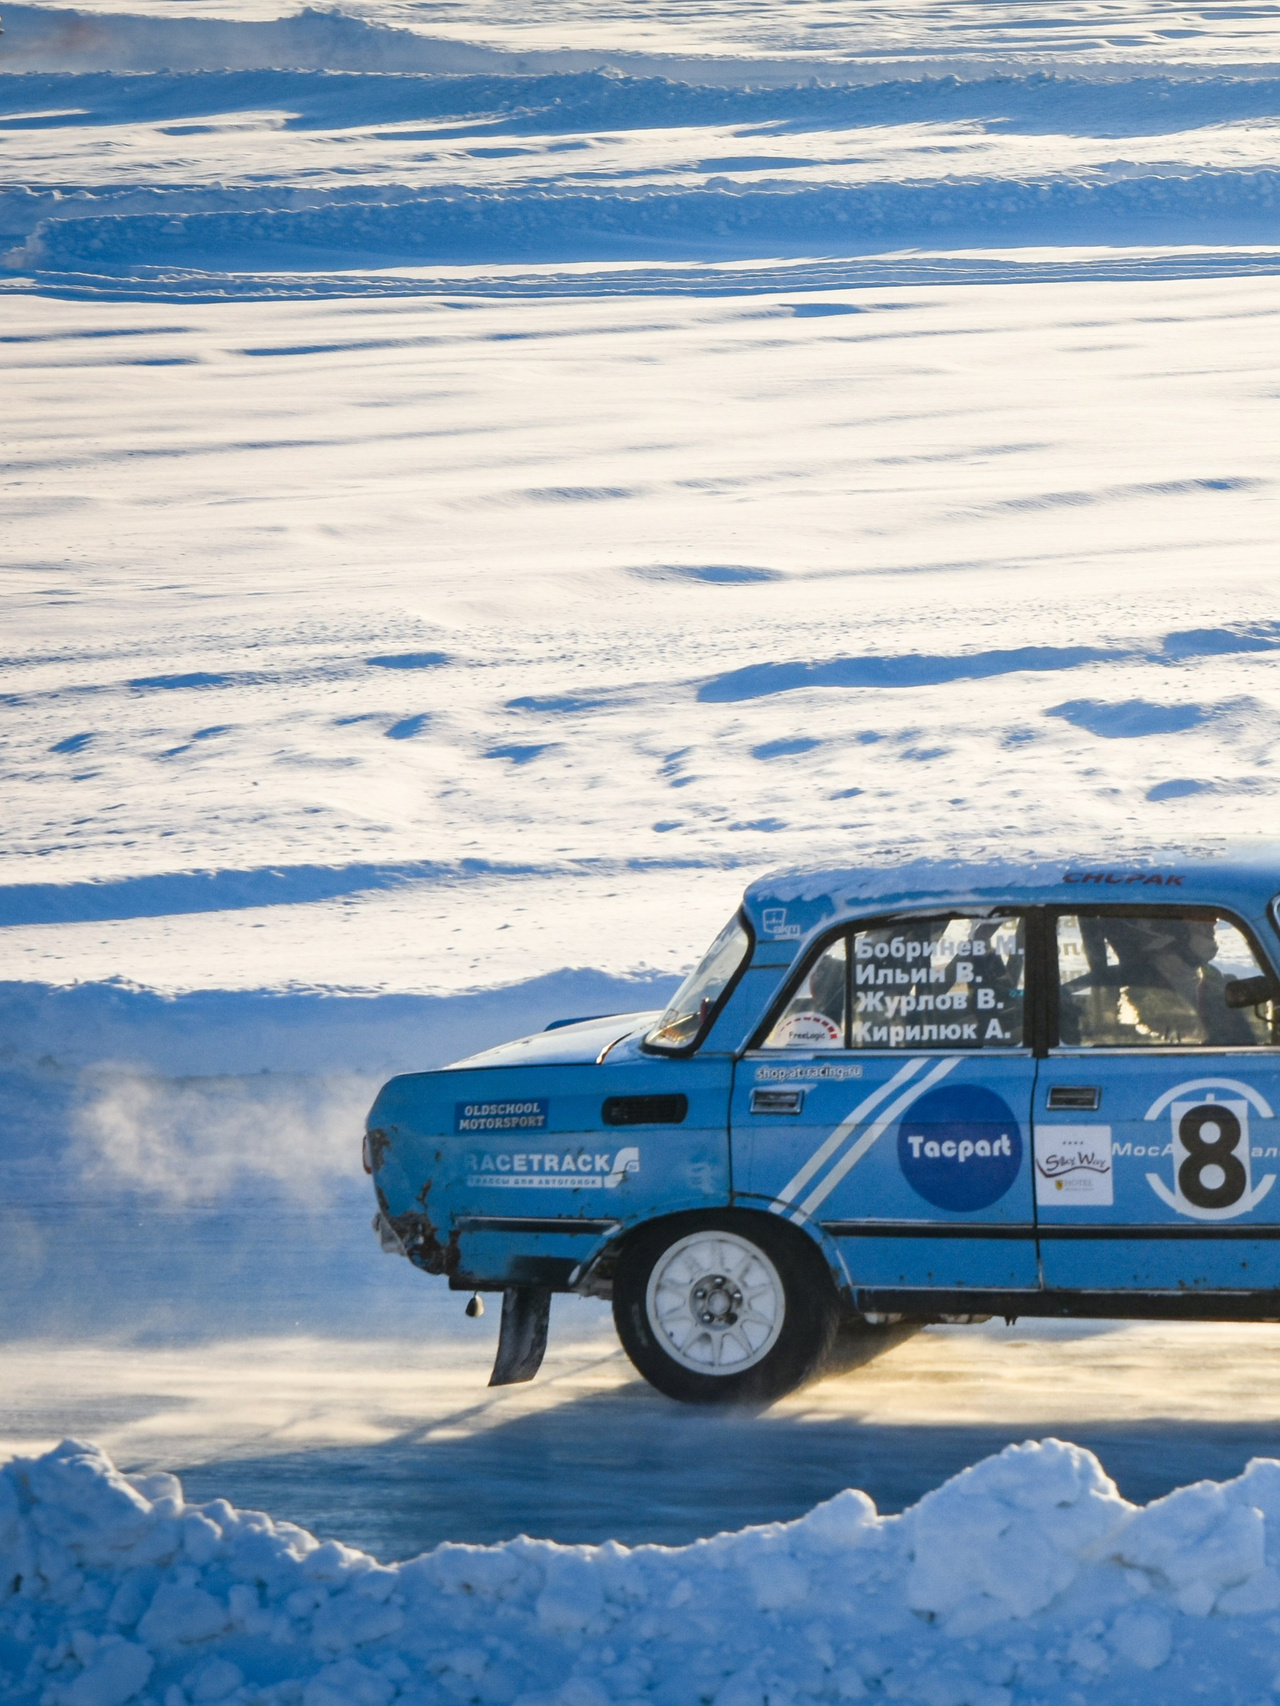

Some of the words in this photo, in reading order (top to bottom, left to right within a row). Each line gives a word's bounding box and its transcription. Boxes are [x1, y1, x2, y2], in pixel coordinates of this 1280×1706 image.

[855, 963, 946, 985] Ильин
[956, 961, 983, 983] В.
[856, 991, 968, 1018] Журлов
[977, 988, 1005, 1010] В.
[855, 1020, 977, 1047] Кирилюк
[984, 1018, 1011, 1039] А.
[464, 1102, 541, 1117] OLDSCHOOL
[459, 1115, 545, 1130] MOTORSPORT
[463, 1153, 610, 1172] RACETRACK
[1178, 1104, 1247, 1209] 8
